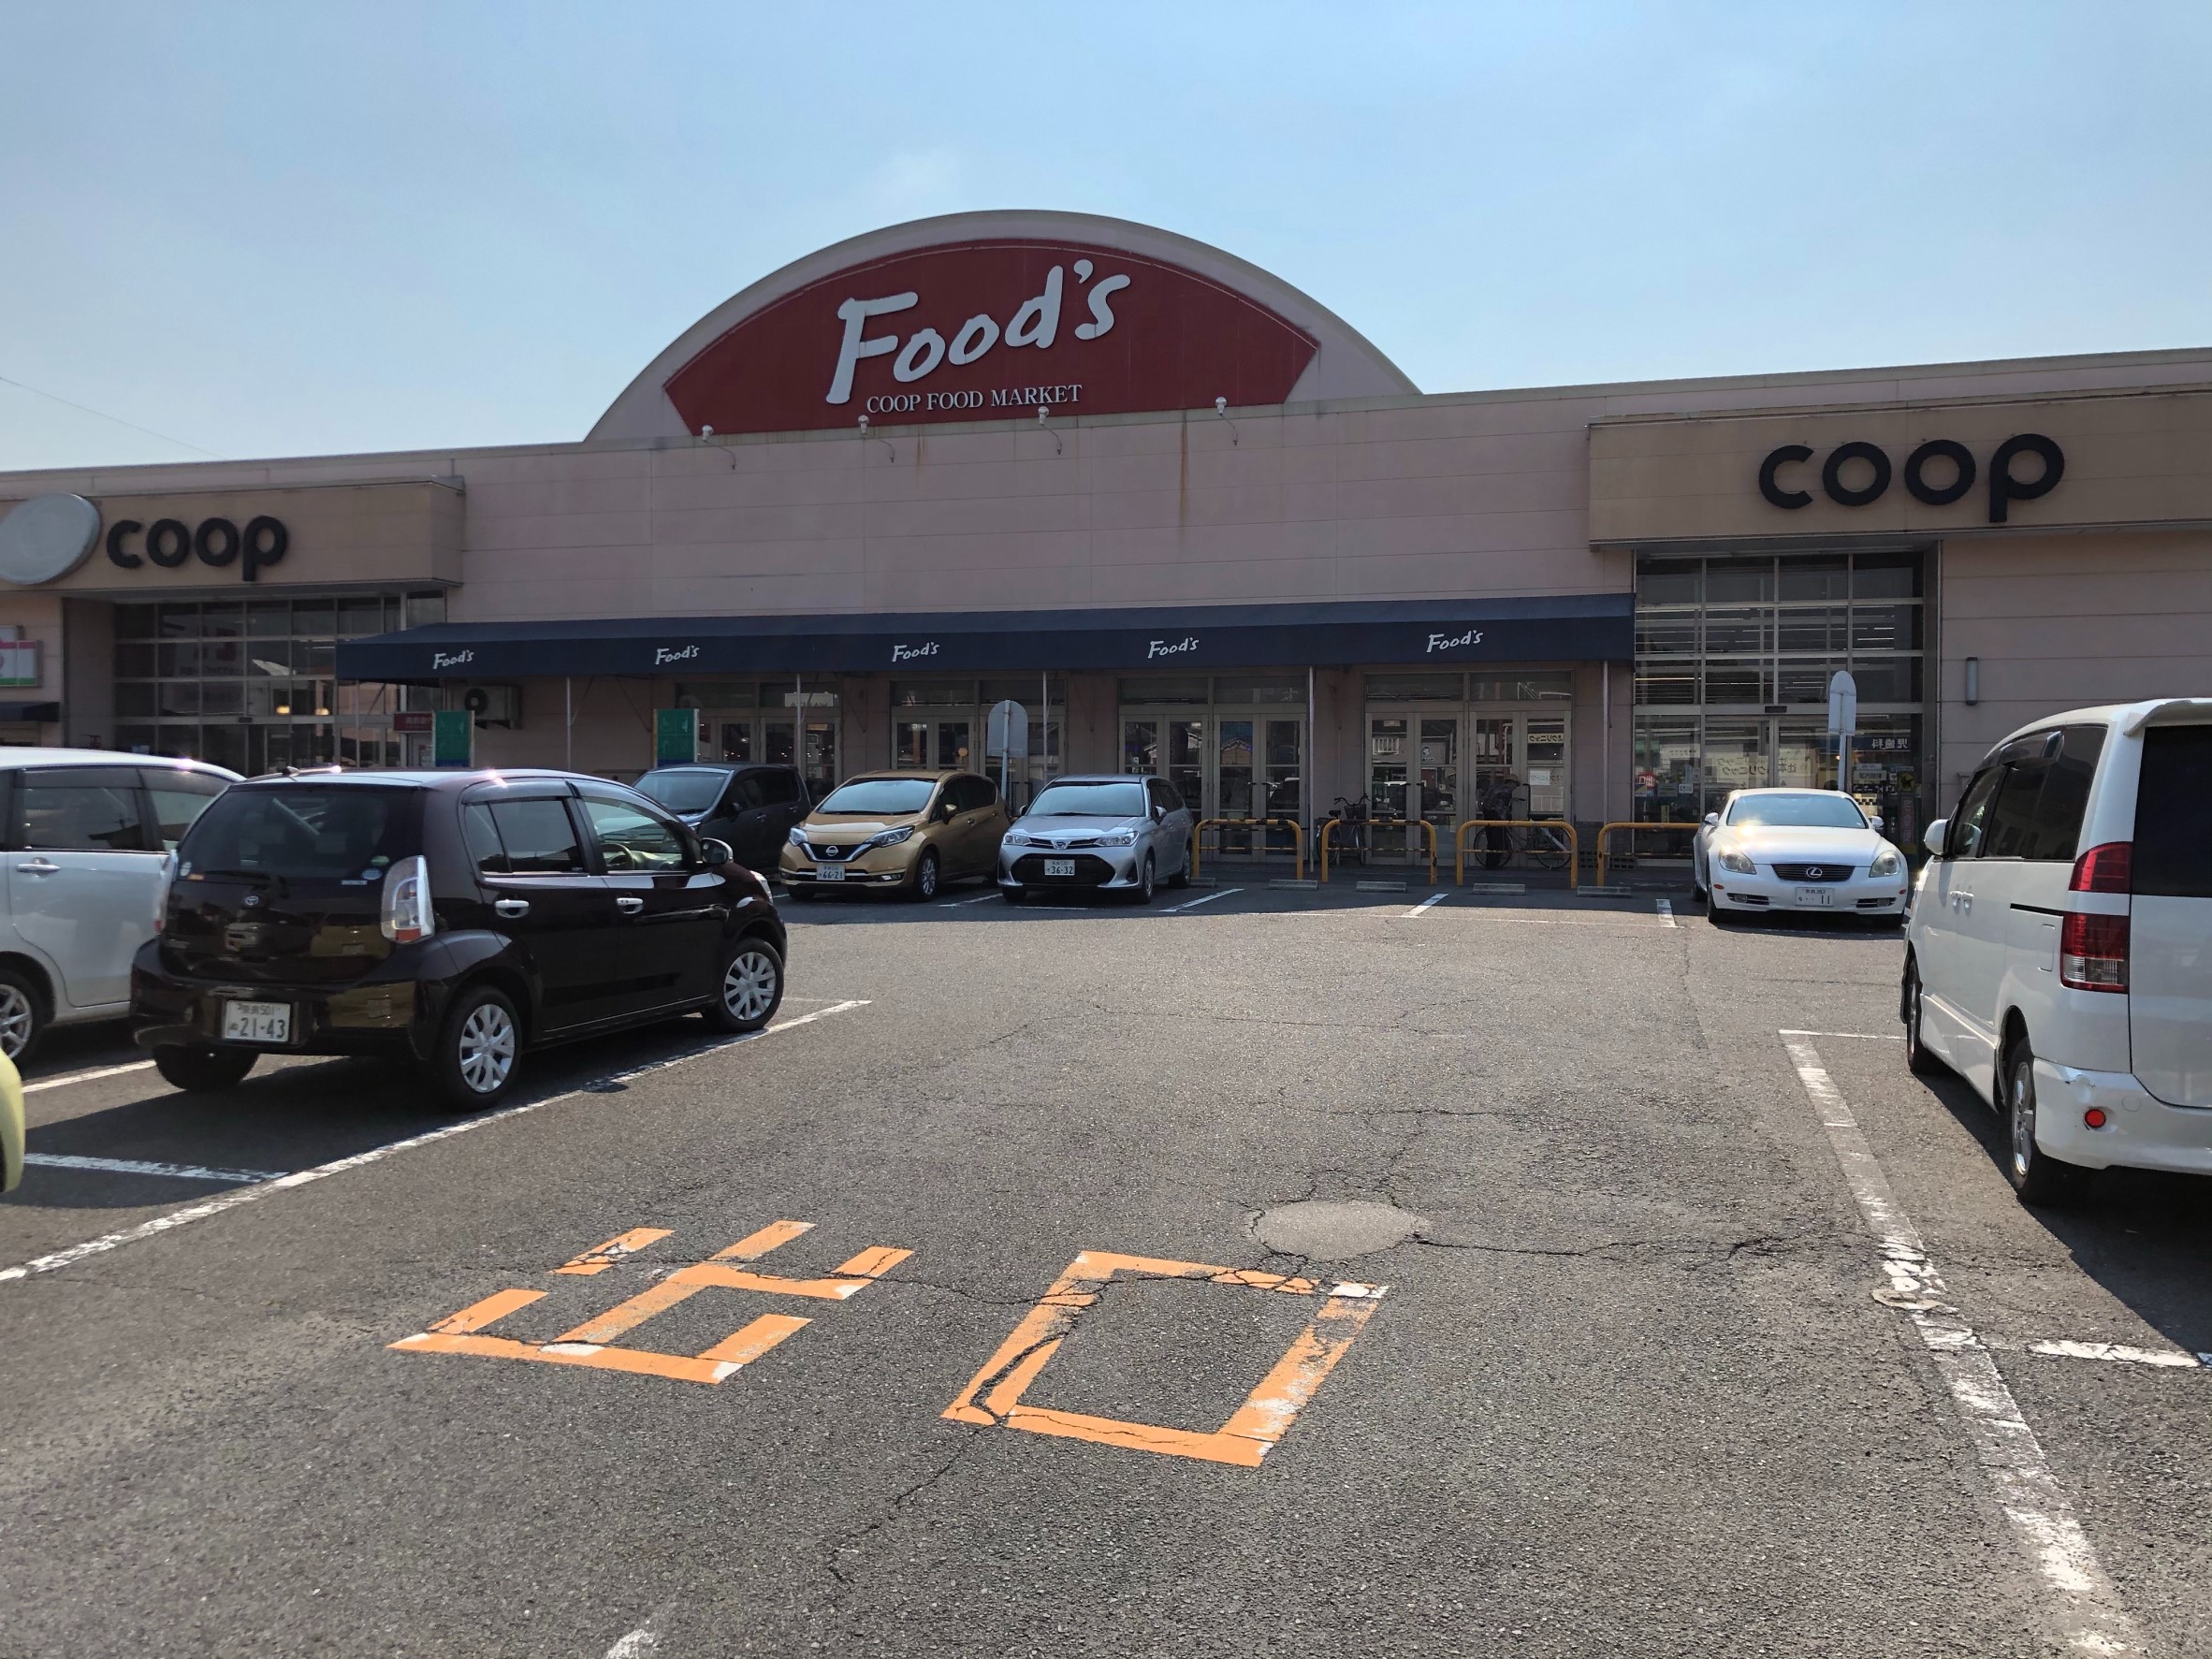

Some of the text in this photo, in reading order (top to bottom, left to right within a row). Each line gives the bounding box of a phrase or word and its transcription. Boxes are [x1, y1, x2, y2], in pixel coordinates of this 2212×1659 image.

[825, 258, 1131, 404] Food's
[866, 384, 1083, 414] COOP FOOD MARKET
[1758, 432, 2066, 524] coop
[106, 515, 288, 582] coop
[892, 642, 939, 662] Food's
[1147, 636, 1200, 659] Food's
[1426, 630, 1484, 653] Food's
[433, 650, 474, 670] Food's
[655, 646, 700, 665] Food's
[822, 870, 843, 880] 66-21
[1051, 866, 1073, 874] 36-32
[240, 1016, 285, 1039] 21-43
[386, 1219, 1390, 1467] 出口
